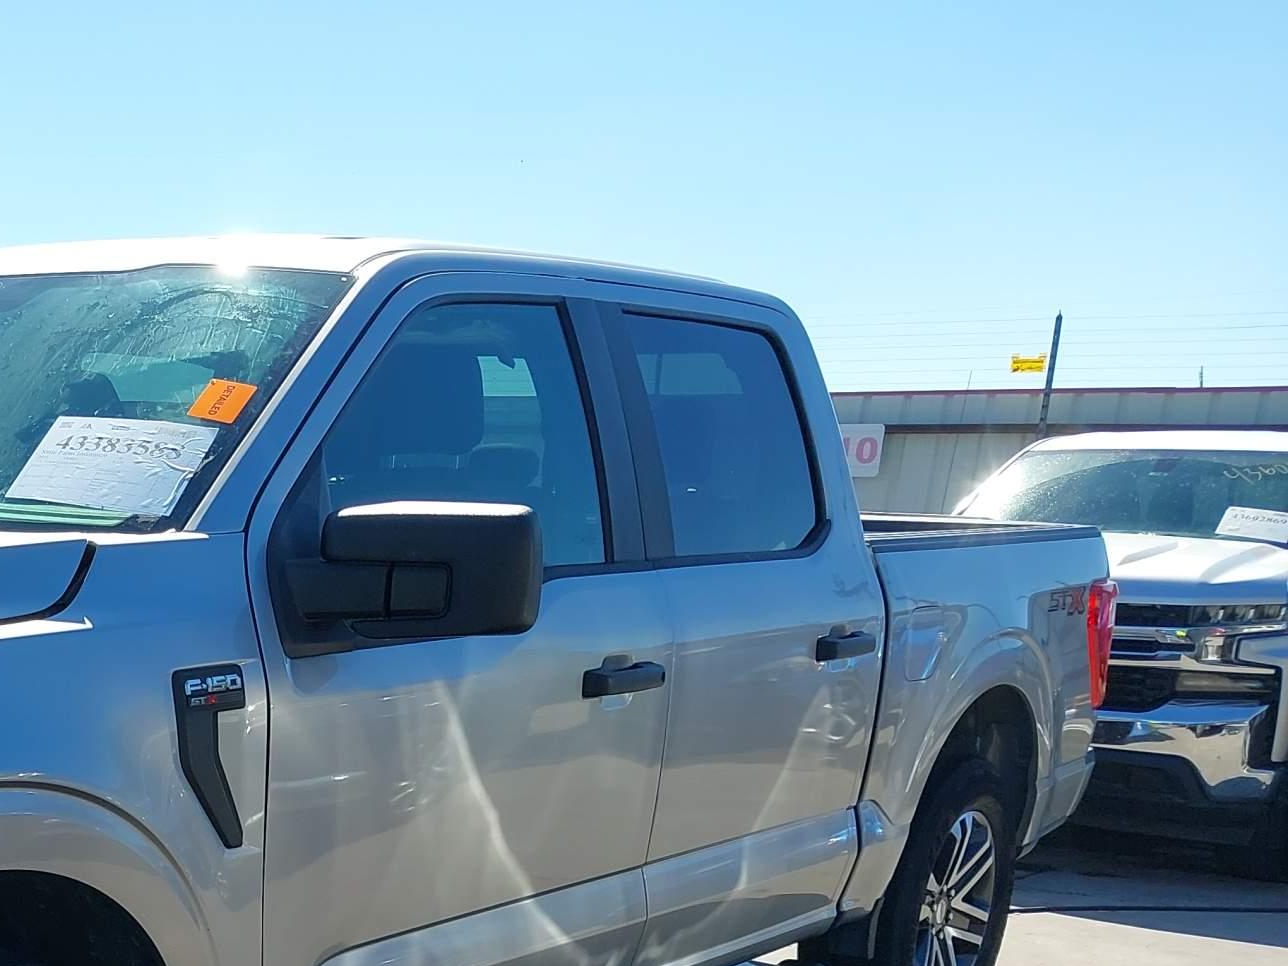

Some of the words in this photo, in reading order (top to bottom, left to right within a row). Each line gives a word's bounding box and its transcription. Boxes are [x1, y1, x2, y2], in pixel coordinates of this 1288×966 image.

[207, 384, 236, 416] DETAILED
[1047, 586, 1086, 616] STX
[184, 673, 242, 696] F-150
